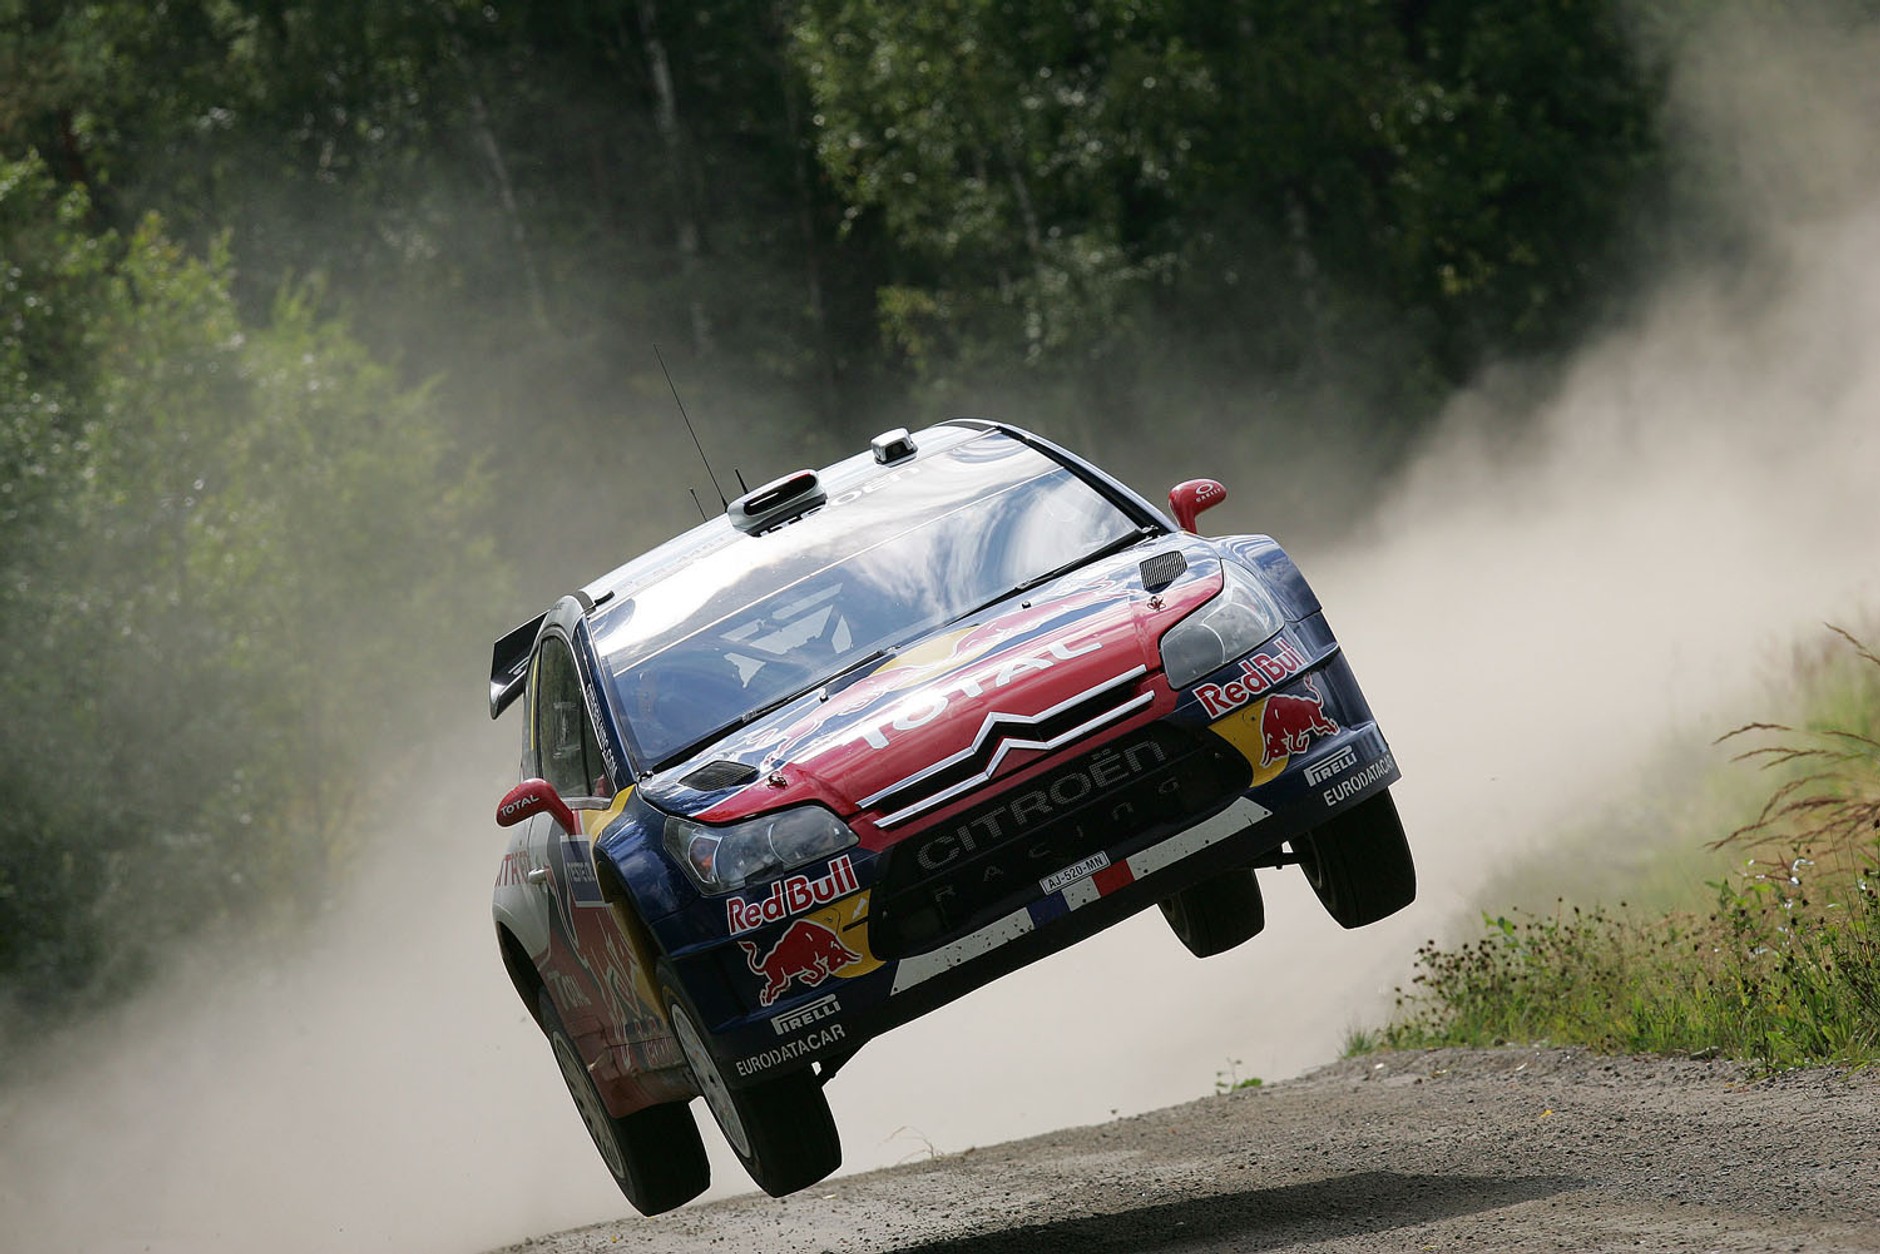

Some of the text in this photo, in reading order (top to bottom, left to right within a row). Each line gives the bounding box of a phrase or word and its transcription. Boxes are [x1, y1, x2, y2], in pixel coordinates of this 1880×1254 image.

[838, 638, 1103, 750] TOTAL
[1304, 746, 1357, 787] PIRELLI
[500, 794, 539, 818] TOTAL
[1046, 856, 1105, 891] AJ-520-MN
[770, 994, 842, 1035] PIRELLI
[736, 1023, 846, 1076] EURODATACAR
